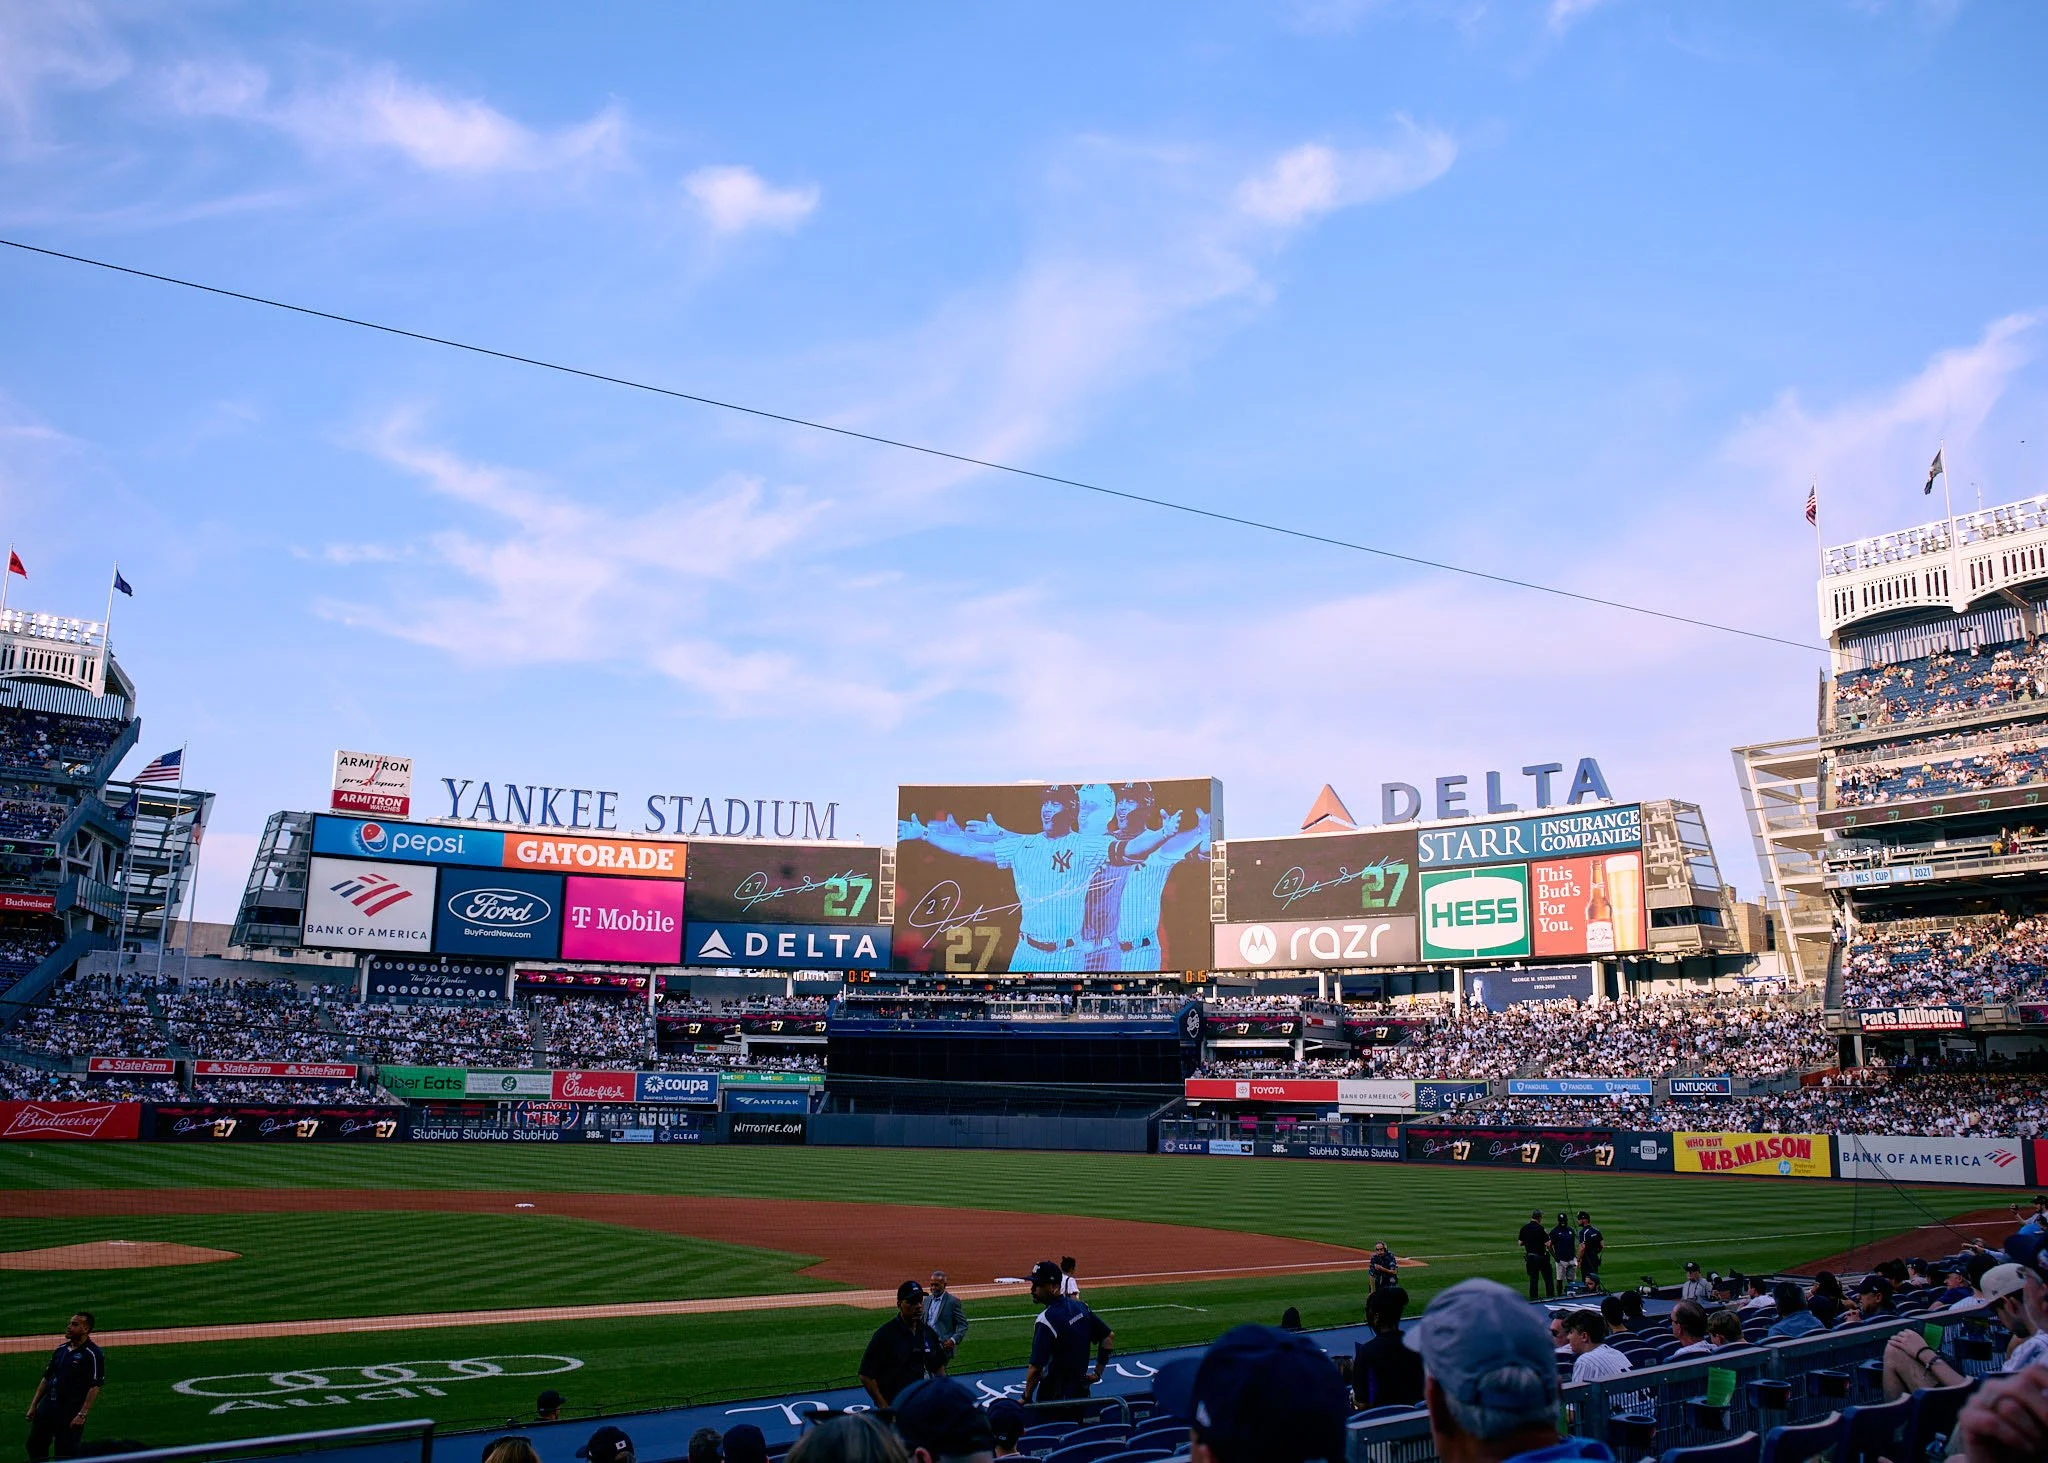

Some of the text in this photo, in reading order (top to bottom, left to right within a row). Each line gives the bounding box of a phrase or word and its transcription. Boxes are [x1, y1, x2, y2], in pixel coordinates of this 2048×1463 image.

[340, 757, 409, 773] ARMITRON
[1381, 757, 1613, 824] DELTA
[340, 793, 403, 808] ARMITRON
[370, 804, 401, 813] WATCHES
[441, 777, 839, 840] YANKEE STADIUM
[1540, 810, 1640, 837] INSURANCE
[392, 833, 464, 856] pepsi
[1418, 826, 1529, 863] STARR
[1541, 826, 1641, 852] COMPANIES
[516, 841, 674, 871] GATORADE
[1537, 866, 1572, 883] This
[1856, 868, 1931, 883] MLS CUP 2021
[1361, 864, 1409, 909] 27
[1538, 882, 1581, 899] Bud's
[5, 898, 53, 908] Budweiser
[824, 878, 873, 918] 27
[466, 892, 533, 922] Ford
[1432, 897, 1518, 928] HESS
[1539, 901, 1565, 916] For
[596, 908, 675, 933] Mobile
[1538, 918, 1574, 933] You.
[307, 924, 427, 940] BANK OF AMERICA
[464, 928, 531, 939] BuyFordNow.com
[745, 932, 878, 959] DELTA
[946, 926, 1001, 972] 27
[1290, 924, 1391, 961] razr
[410, 974, 466, 986] New York Yankees
[848, 970, 870, 983] 0:15
[1186, 970, 1207, 983] 0:15
[1860, 1008, 1963, 1026] Parts Authority
[689, 1024, 701, 1034] 27
[771, 1021, 784, 1032] 27
[815, 1022, 827, 1032] 27
[1238, 1023, 1250, 1035] 27
[1282, 1022, 1294, 1034] 27
[1376, 1027, 1388, 1039] 27
[382, 1076, 419, 1089] Uber
[424, 1076, 462, 1090] Eats
[563, 1078, 625, 1099] Chick-fil-A
[664, 1079, 709, 1094] coupa
[1252, 1086, 1285, 1095] TOYOTA
[1674, 1082, 1718, 1092] UNTUCKit
[16, 1112, 102, 1128] Budweiser
[214, 1120, 237, 1138] 27
[296, 1120, 319, 1138] 27
[376, 1121, 397, 1138] 27
[413, 1128, 459, 1140] StubHub
[462, 1128, 509, 1140] StubHub
[513, 1129, 559, 1141] StubHub
[734, 1123, 802, 1134] NITTOTIRE.COM
[1453, 1140, 1471, 1161] 27
[1686, 1138, 1724, 1148] WHO BUT
[1309, 1146, 1339, 1156] StubHub
[1341, 1147, 1370, 1157] StubHub
[1371, 1148, 1399, 1159] StubHub
[1522, 1144, 1541, 1163] 27
[1594, 1146, 1615, 1166] 27
[1843, 1152, 1982, 1167] BANK OF AMERICA
[209, 1385, 448, 1415] Audi
